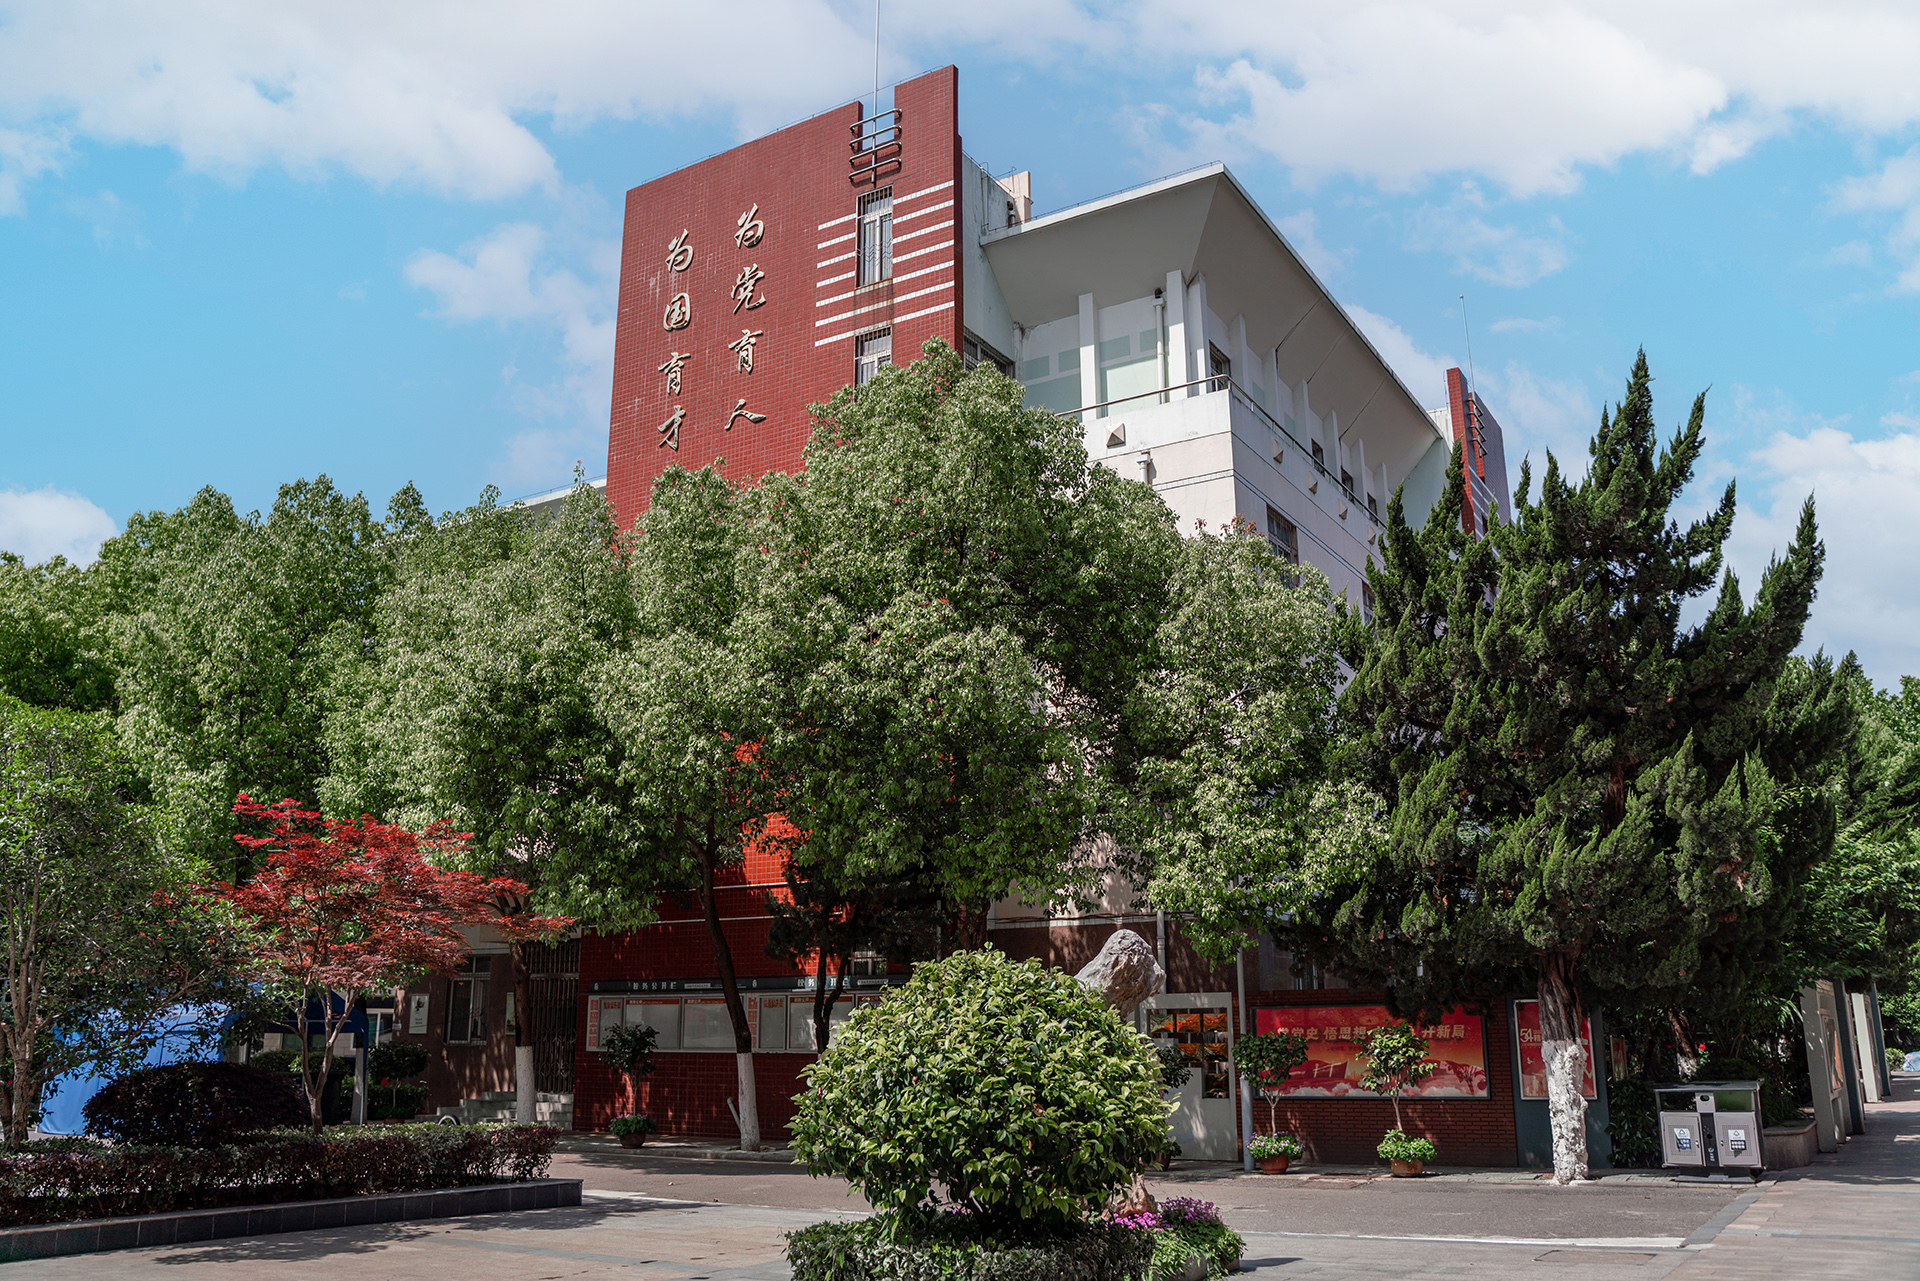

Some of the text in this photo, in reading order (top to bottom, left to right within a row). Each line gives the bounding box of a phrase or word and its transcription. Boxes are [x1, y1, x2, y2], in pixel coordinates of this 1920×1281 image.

[658, 229, 694, 451] 为国育才
[724, 203, 767, 431] 为党育人
[1323, 1025, 1367, 1041] 悟思想
[1421, 1024, 1465, 1039] 开新局
